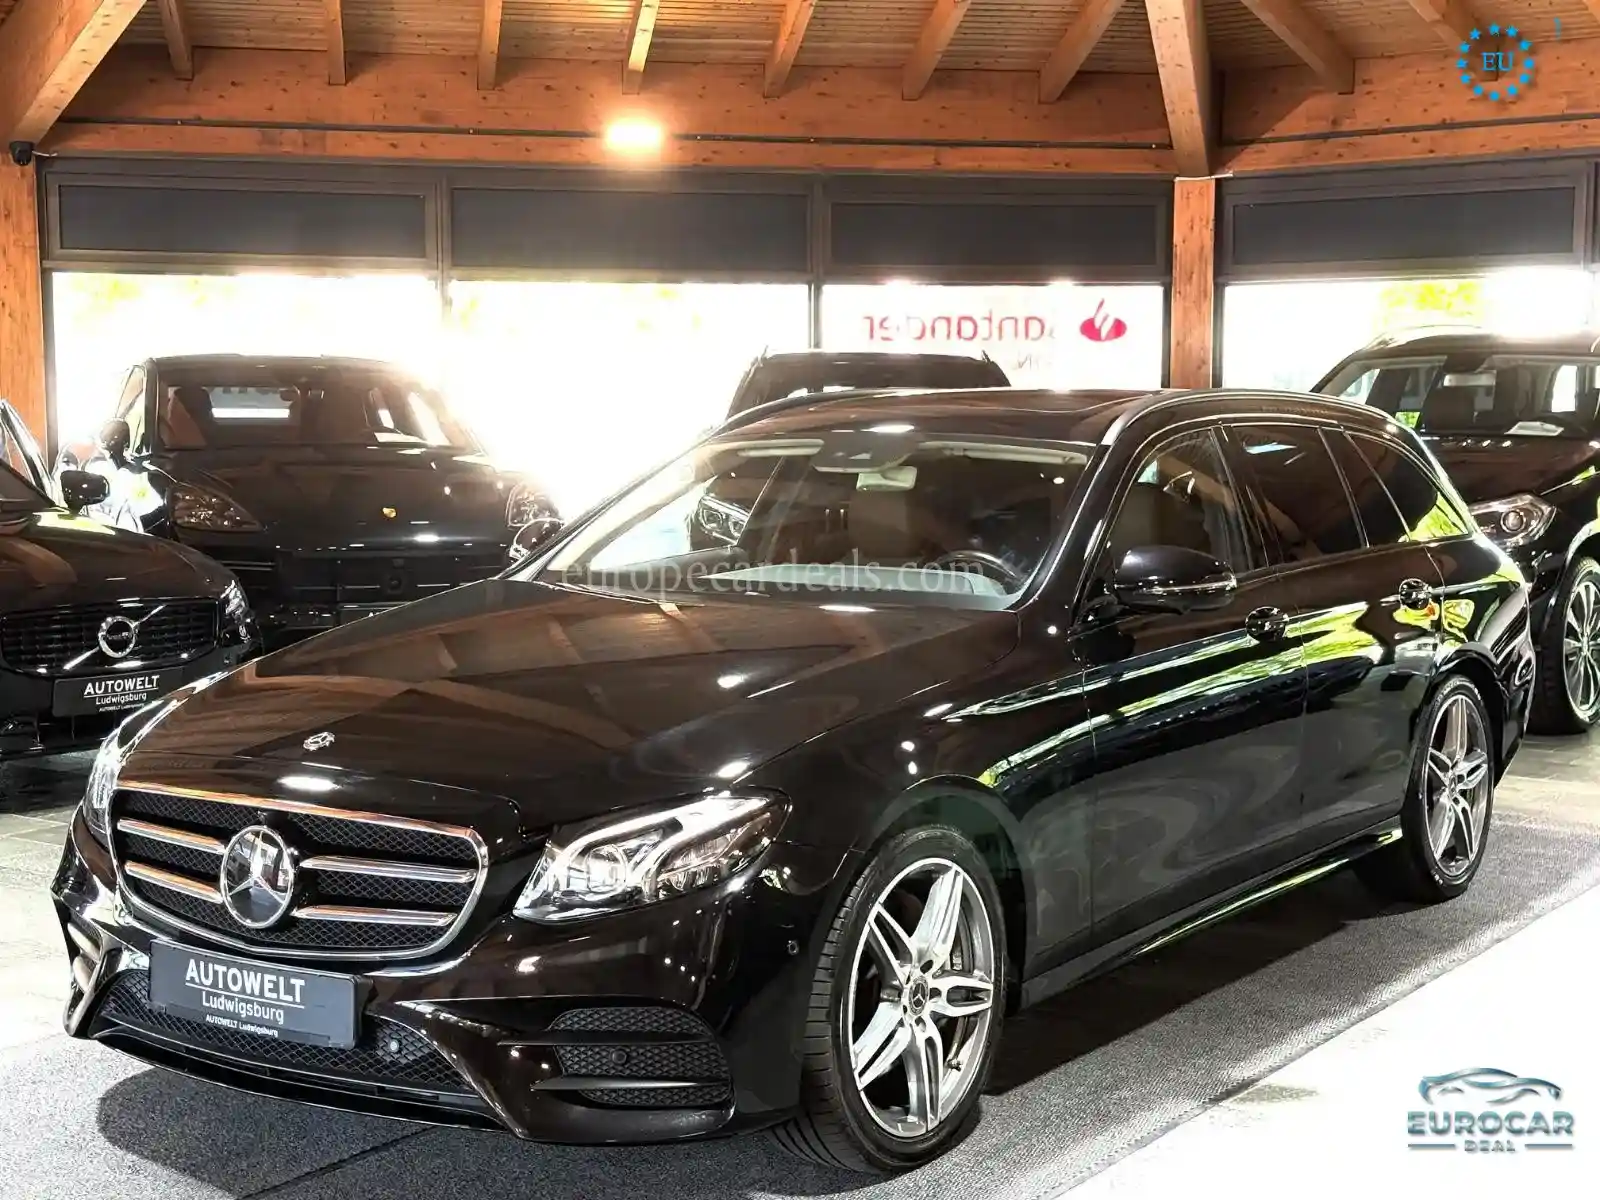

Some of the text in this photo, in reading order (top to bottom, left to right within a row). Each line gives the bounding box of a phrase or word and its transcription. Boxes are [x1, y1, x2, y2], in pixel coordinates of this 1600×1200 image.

[84, 674, 160, 695] AUTOWELT
[96, 692, 147, 705] Ludwigsburg
[185, 958, 305, 1003] AUTOWELT
[202, 991, 285, 1025] Ludwigsburg
[205, 1013, 279, 1038] AUTOWELT Ludwigsburg
